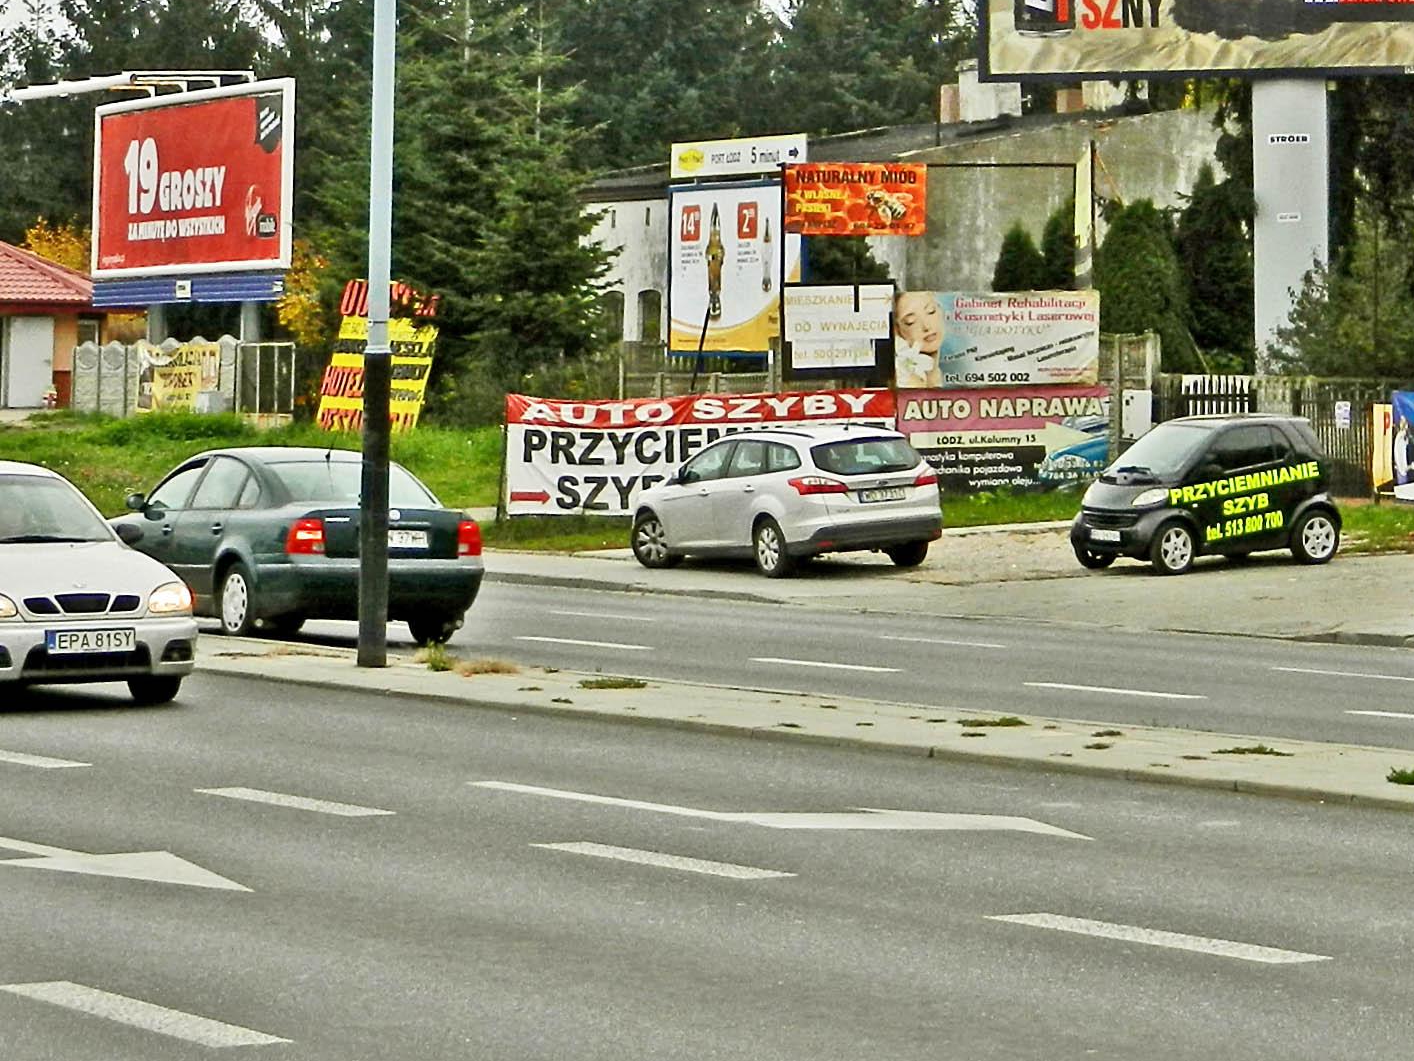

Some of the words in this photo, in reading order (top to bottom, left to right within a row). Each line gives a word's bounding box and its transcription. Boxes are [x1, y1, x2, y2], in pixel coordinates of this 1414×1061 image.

[751, 146, 758, 164] 5
[124, 137, 158, 215] 19
[159, 165, 226, 212] GROSZY
[796, 169, 875, 184] NATURALNY
[880, 168, 917, 184] MIÓD
[165, 219, 178, 238] DO
[683, 211, 695, 235] 14
[956, 298, 1003, 310] Gabinet
[954, 311, 1025, 324] Kosmetyki
[1028, 311, 1095, 323] Laserowej
[965, 373, 985, 383] 694
[987, 373, 1007, 382] 502
[1010, 372, 1030, 382] 002
[521, 402, 676, 424] AUTO
[692, 392, 876, 420] SZYBY
[903, 398, 971, 421] AUTO
[978, 395, 1104, 419] NAPRAWA
[1026, 434, 1036, 442] 15
[958, 450, 1014, 464] komputerowa
[973, 463, 1023, 476] pojazdowa
[1169, 461, 1320, 505] PRZYCIEMNIANIE
[1223, 492, 1269, 516] SZYB
[1225, 518, 1243, 537] 513
[1245, 516, 1263, 533] 800
[1265, 510, 1283, 529] 700
[58, 634, 90, 649] EPA
[95, 632, 132, 648] 81SY
